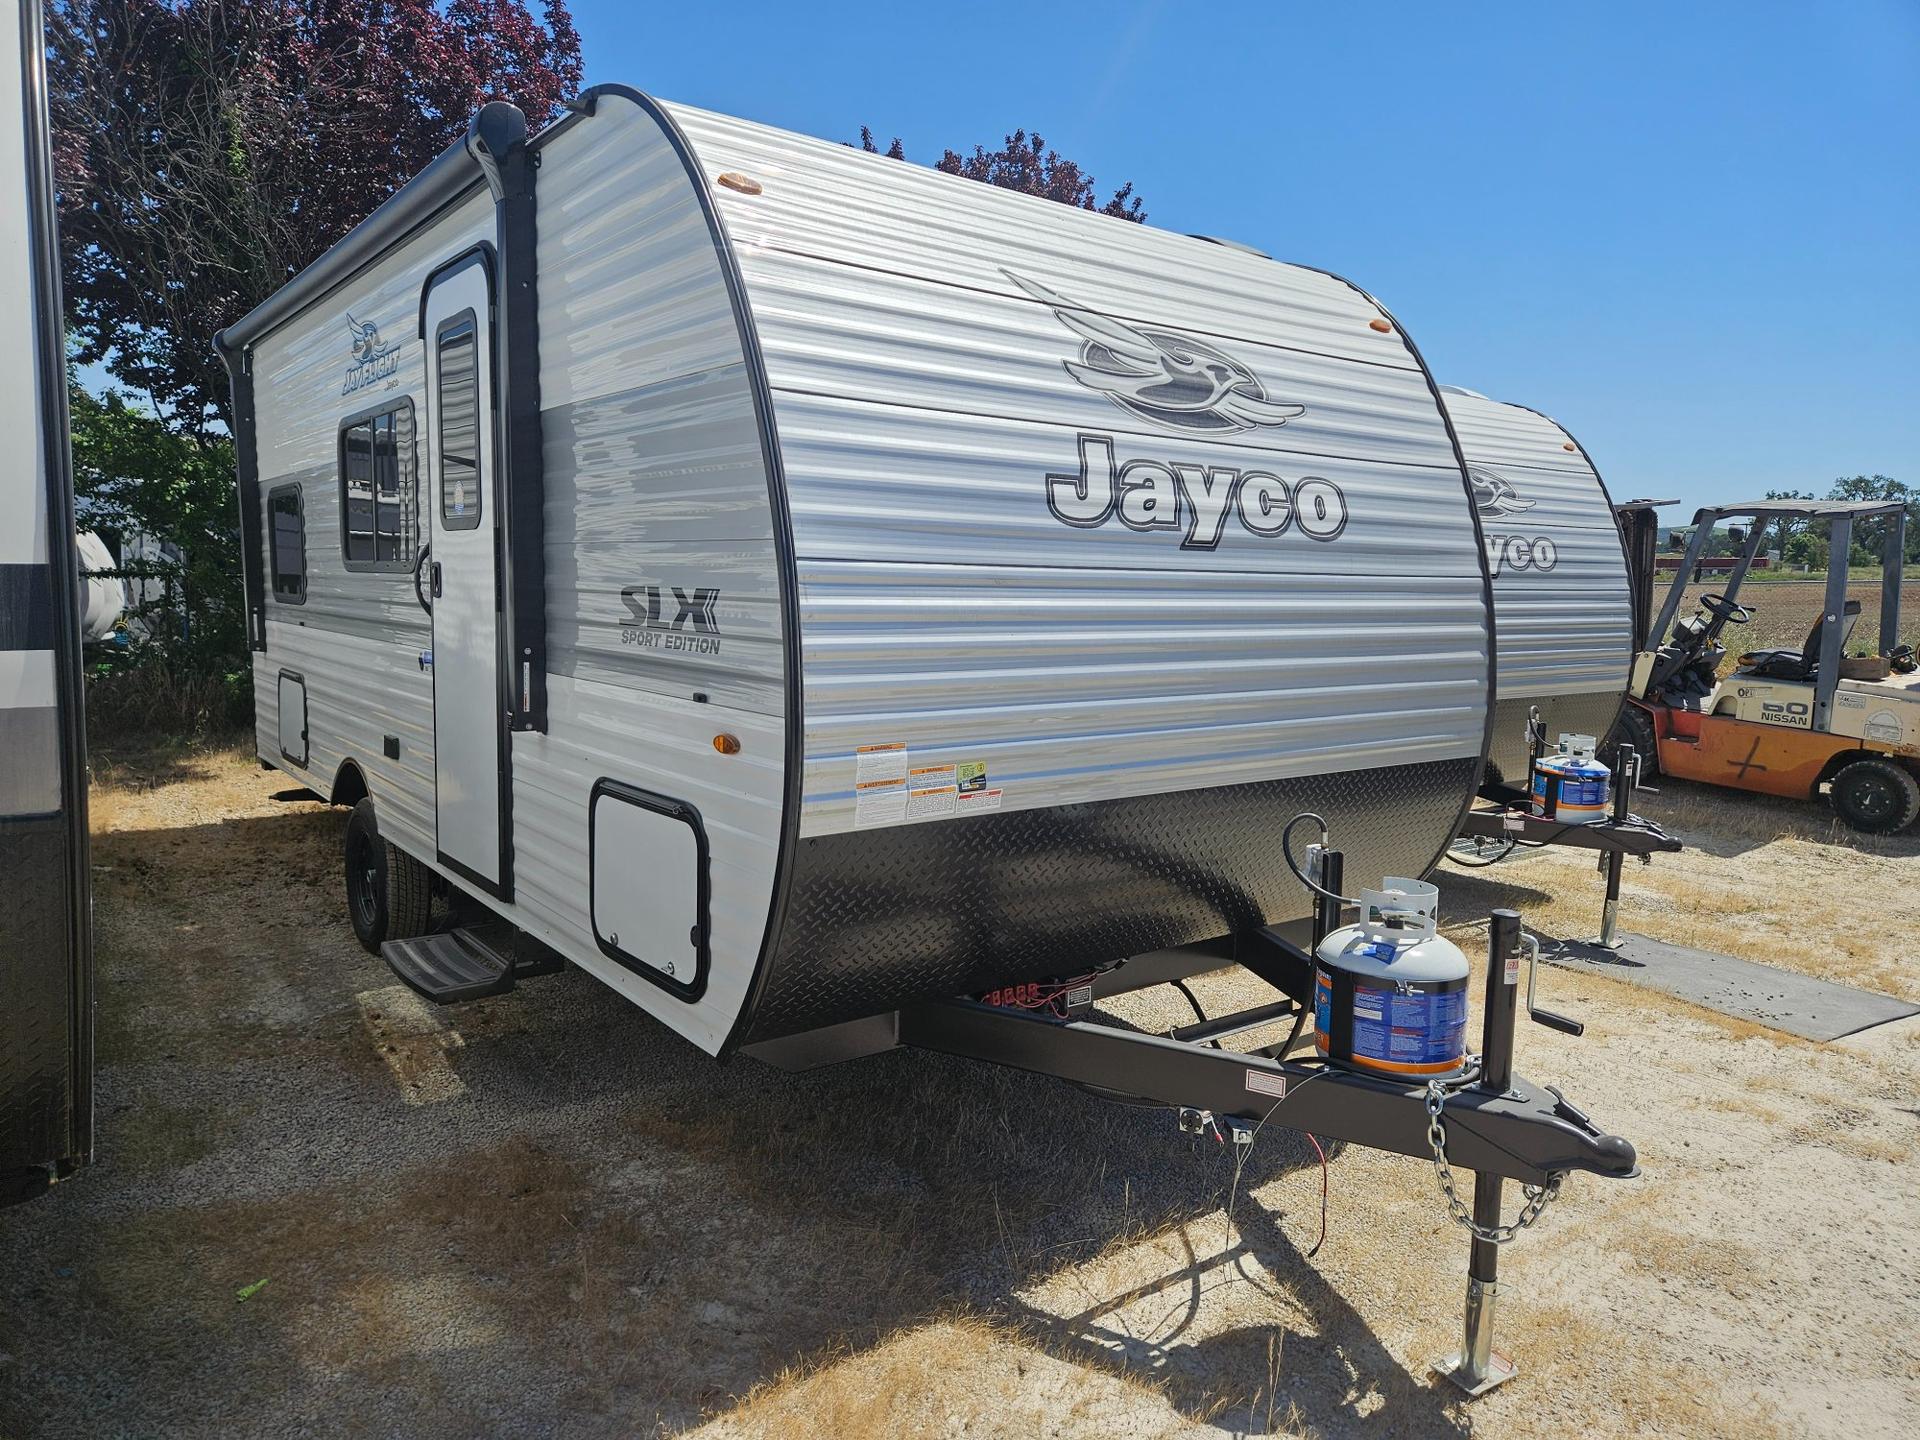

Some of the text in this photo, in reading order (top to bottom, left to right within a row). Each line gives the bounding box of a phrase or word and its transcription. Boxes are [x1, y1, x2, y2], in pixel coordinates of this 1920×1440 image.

[1045, 432, 1349, 552] Jayco
[619, 585, 721, 634] SLX
[621, 629, 721, 655] SPORT EDITION
[1761, 712, 1808, 726] NISSAN
